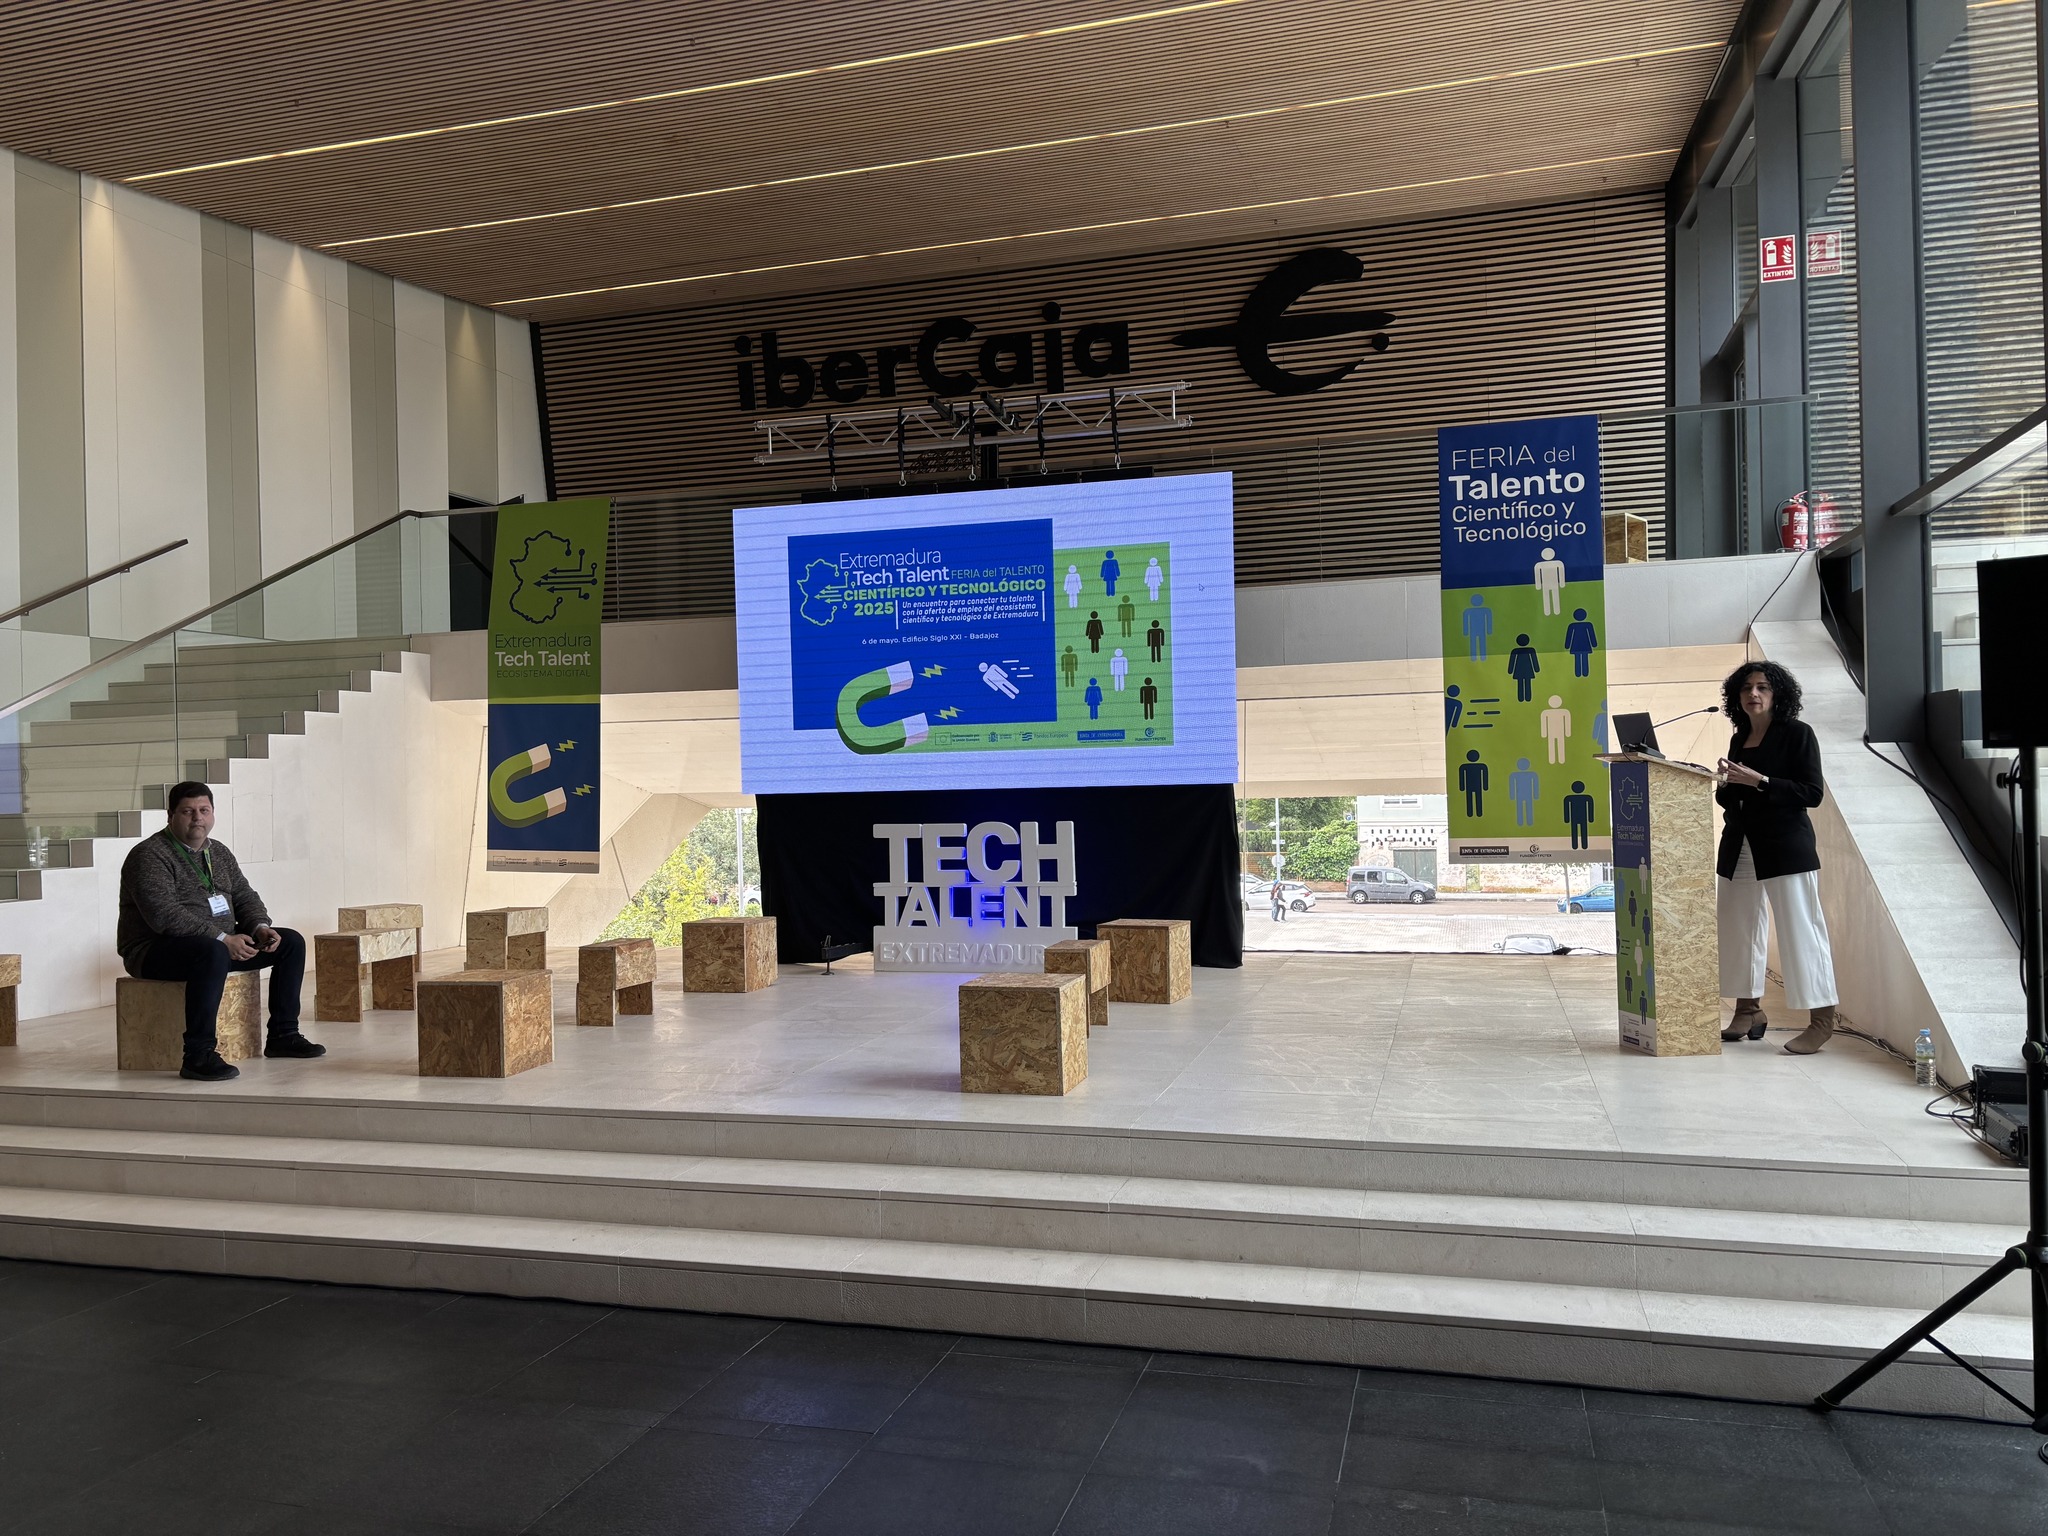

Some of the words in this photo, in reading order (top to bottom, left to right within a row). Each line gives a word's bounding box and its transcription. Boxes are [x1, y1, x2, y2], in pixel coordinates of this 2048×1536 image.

[1764, 270, 1793, 278] EXTINTOR
[1452, 444, 1535, 470] FERIA
[1544, 446, 1575, 464] del
[1448, 468, 1585, 501] Talento
[1452, 501, 1556, 523] Científico
[1562, 502, 1575, 520] y
[1454, 520, 1586, 543] Tecnológico
[840, 548, 941, 569] Extremadura
[853, 567, 893, 585] Tech
[897, 566, 949, 584] Talent
[951, 569, 980, 579] FERIA
[983, 567, 997, 578] del
[999, 565, 1044, 576] TALENTO
[844, 584, 925, 601] CIENTÍFICO
[926, 585, 938, 597] Y
[940, 577, 1046, 596] TECNOLÓGICO
[854, 602, 894, 616] 2025
[913, 600, 948, 608] encuentro
[950, 599, 965, 609] para
[966, 597, 998, 605] conectar
[1009, 594, 1035, 603] talento
[924, 607, 946, 615] oferta
[947, 606, 956, 614] de
[958, 605, 982, 614] empleo
[984, 604, 995, 612] del
[996, 602, 1036, 611] ecosistema
[983, 612, 992, 620] de
[993, 610, 1039, 619] Extremadura
[496, 632, 592, 649] Extremadura
[930, 635, 948, 643] Siglo
[970, 632, 999, 641] Badajoz
[494, 650, 534, 667] Tech
[538, 650, 591, 666] Talent
[496, 670, 553, 678] ECOSISTEMA
[556, 670, 590, 678] DIGITAL
[1616, 824, 1645, 833] Extremadura
[1617, 832, 1629, 840] Tech
[1629, 832, 1645, 840] Talent
[873, 821, 1077, 886] TECH
[873, 886, 1077, 928] TALENT
[880, 943, 1045, 964] EXTREMADUR
